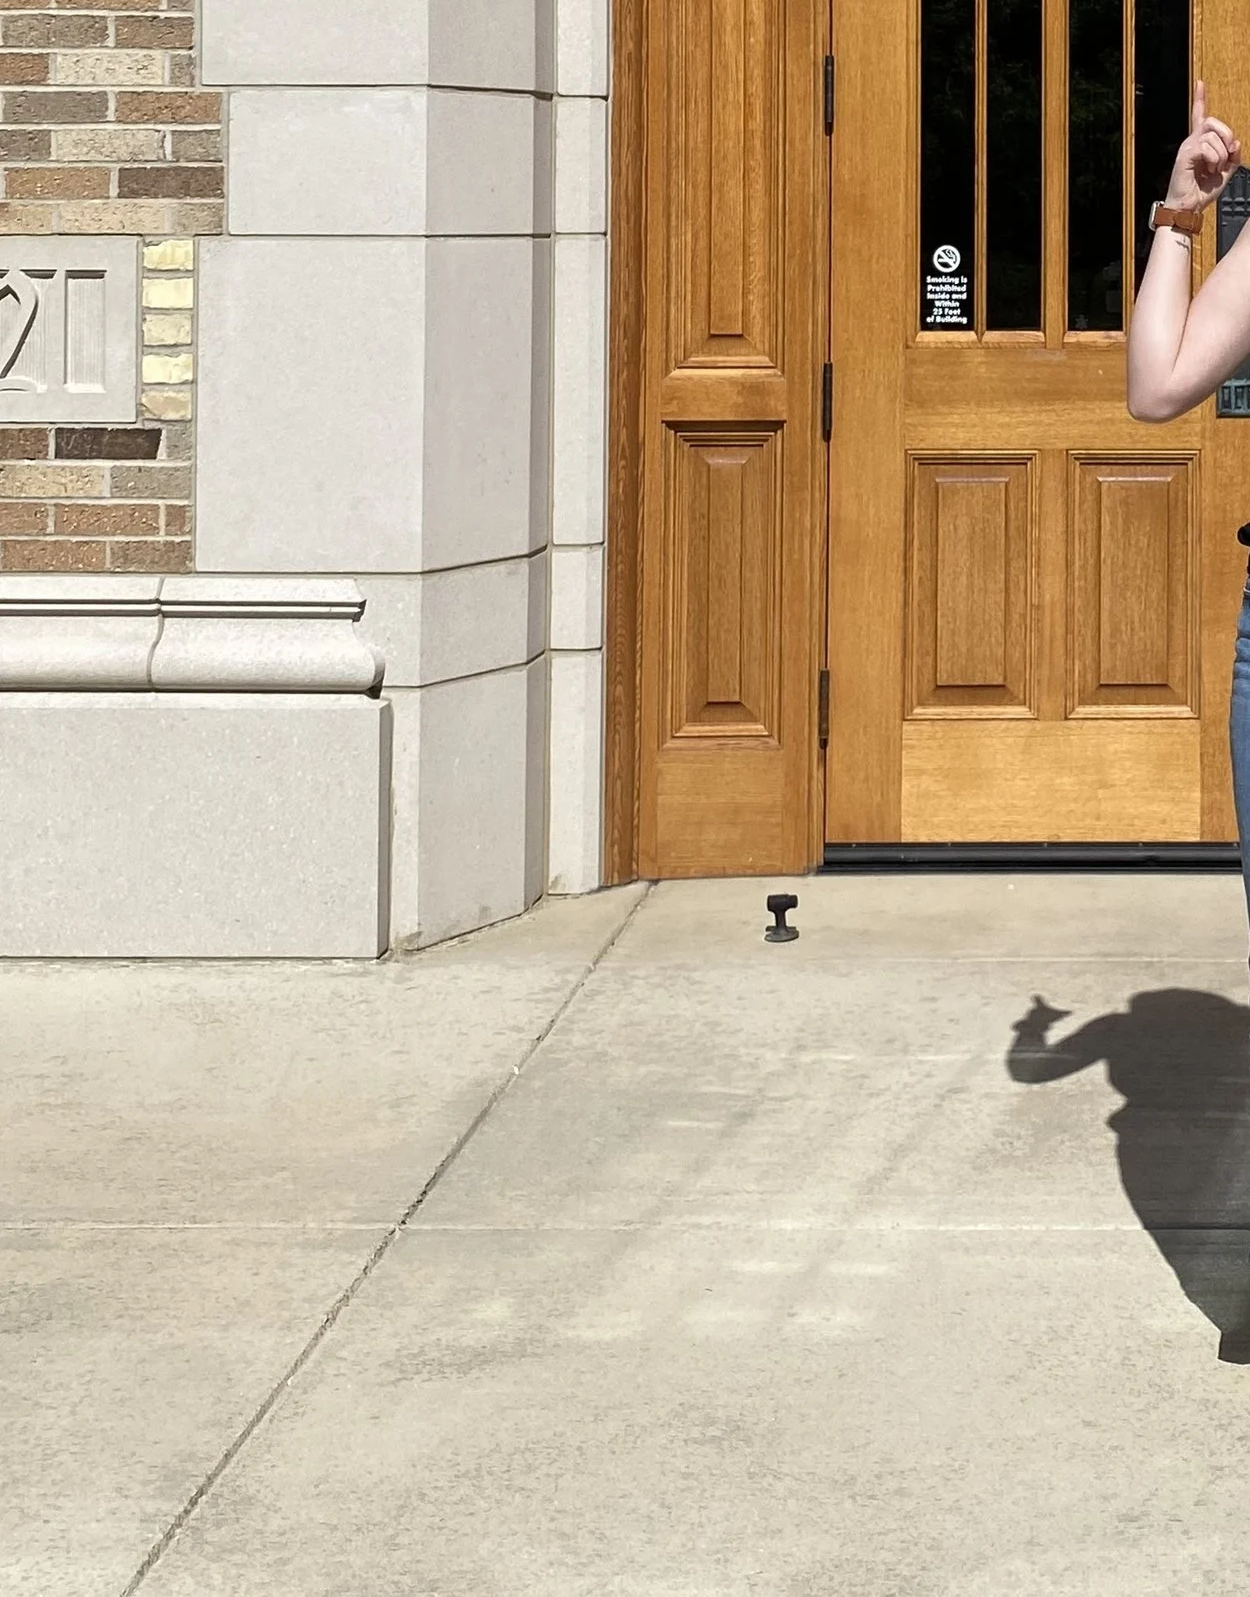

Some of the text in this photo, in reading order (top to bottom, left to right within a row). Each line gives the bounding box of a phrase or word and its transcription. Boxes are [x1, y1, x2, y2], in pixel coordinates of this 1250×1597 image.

[926, 275, 960, 284] Smoking
[927, 284, 967, 292] Prohibited
[926, 315, 968, 324] of Building
